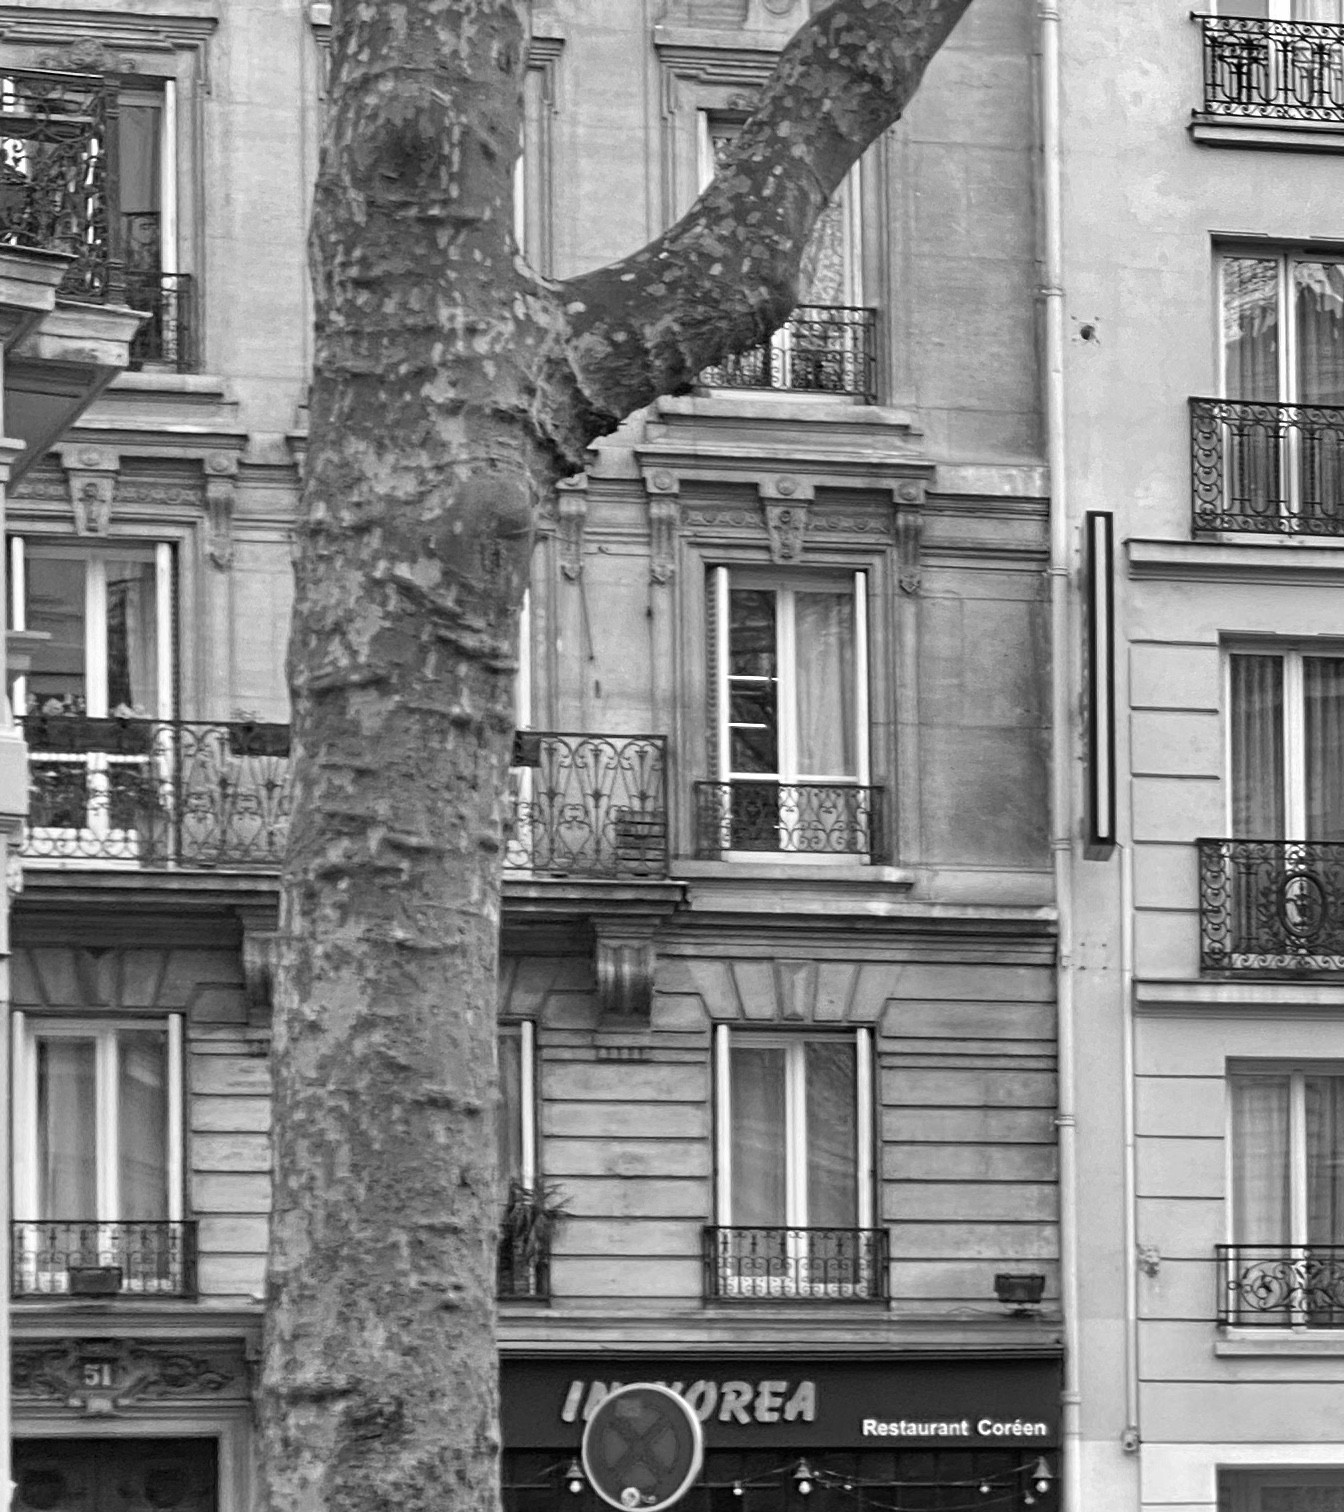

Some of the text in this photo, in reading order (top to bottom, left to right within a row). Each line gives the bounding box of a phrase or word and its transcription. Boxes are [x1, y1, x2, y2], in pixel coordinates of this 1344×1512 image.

[84, 1363, 112, 1386] 51
[650, 1379, 817, 1425] OREA
[862, 1418, 1047, 1437] Restaurant Coréen
